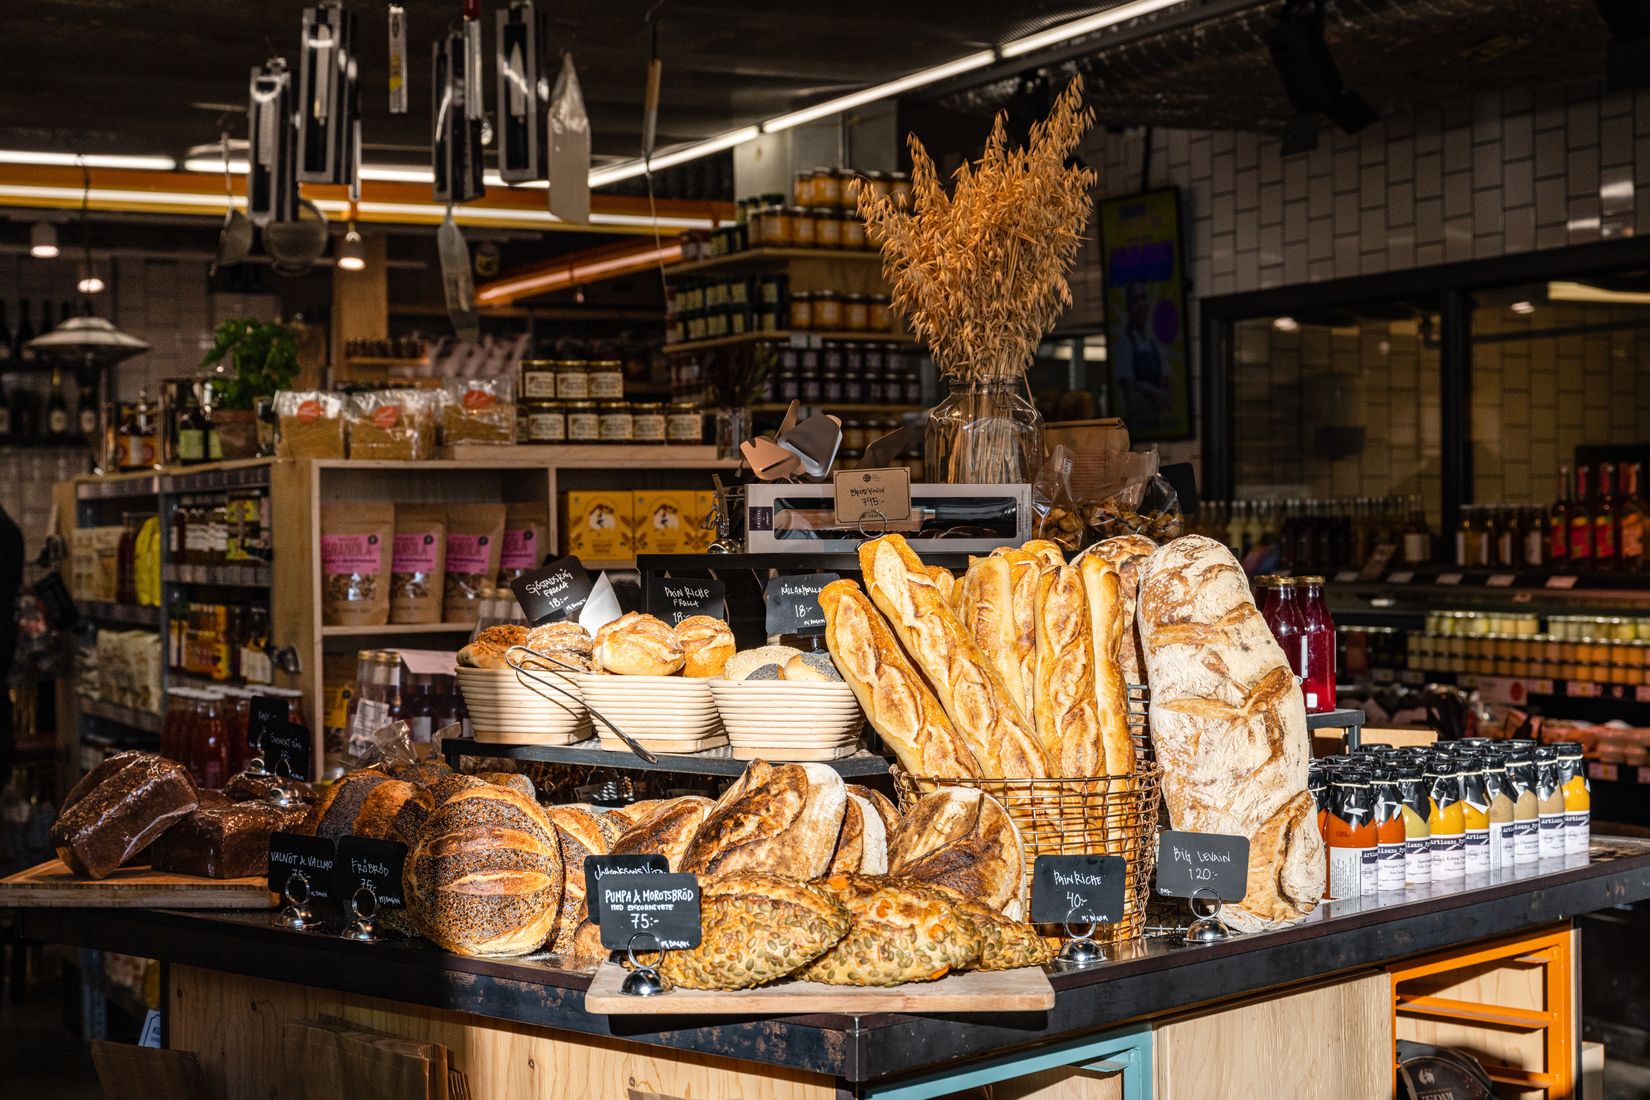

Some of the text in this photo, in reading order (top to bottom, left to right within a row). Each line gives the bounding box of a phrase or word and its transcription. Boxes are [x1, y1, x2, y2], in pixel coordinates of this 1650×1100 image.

[543, 581, 569, 598] FRALLA
[664, 586, 684, 598] PAIN
[548, 596, 569, 609] 18:-
[672, 599, 699, 608] FRALLA
[794, 604, 813, 618] 18:-
[270, 851, 299, 866] VALNÖT
[307, 855, 334, 871] VALLMO
[1173, 846, 1231, 865] BIG LEVAIN
[351, 858, 390, 877] FRÖBRÖD
[1053, 870, 1102, 886] PAIN RICHE
[605, 889, 632, 904] PUMPA
[642, 888, 694, 902] MOROTSBRÖD
[1066, 891, 1088, 908] 40:-
[630, 913, 659, 929] 75:-
